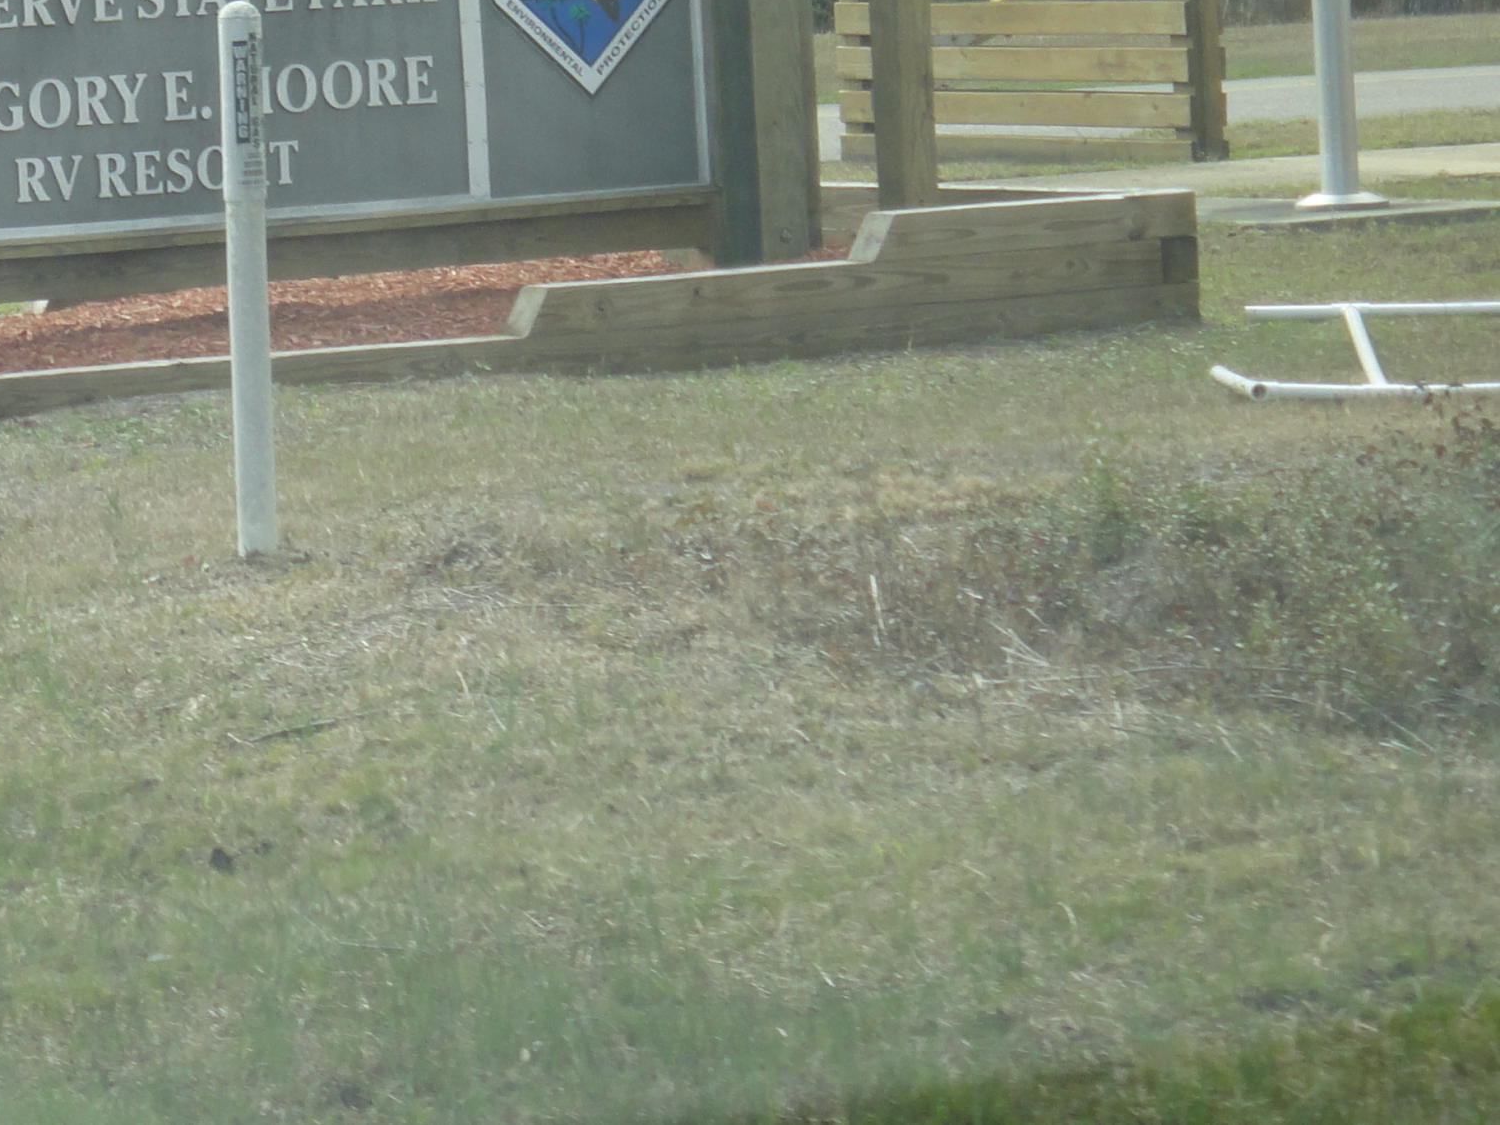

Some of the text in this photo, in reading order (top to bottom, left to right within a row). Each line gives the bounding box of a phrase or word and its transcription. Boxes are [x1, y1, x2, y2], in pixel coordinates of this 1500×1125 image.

[162, 70, 213, 122] E.
[15, 154, 84, 203] RV
[96, 139, 299, 199] RESOT
